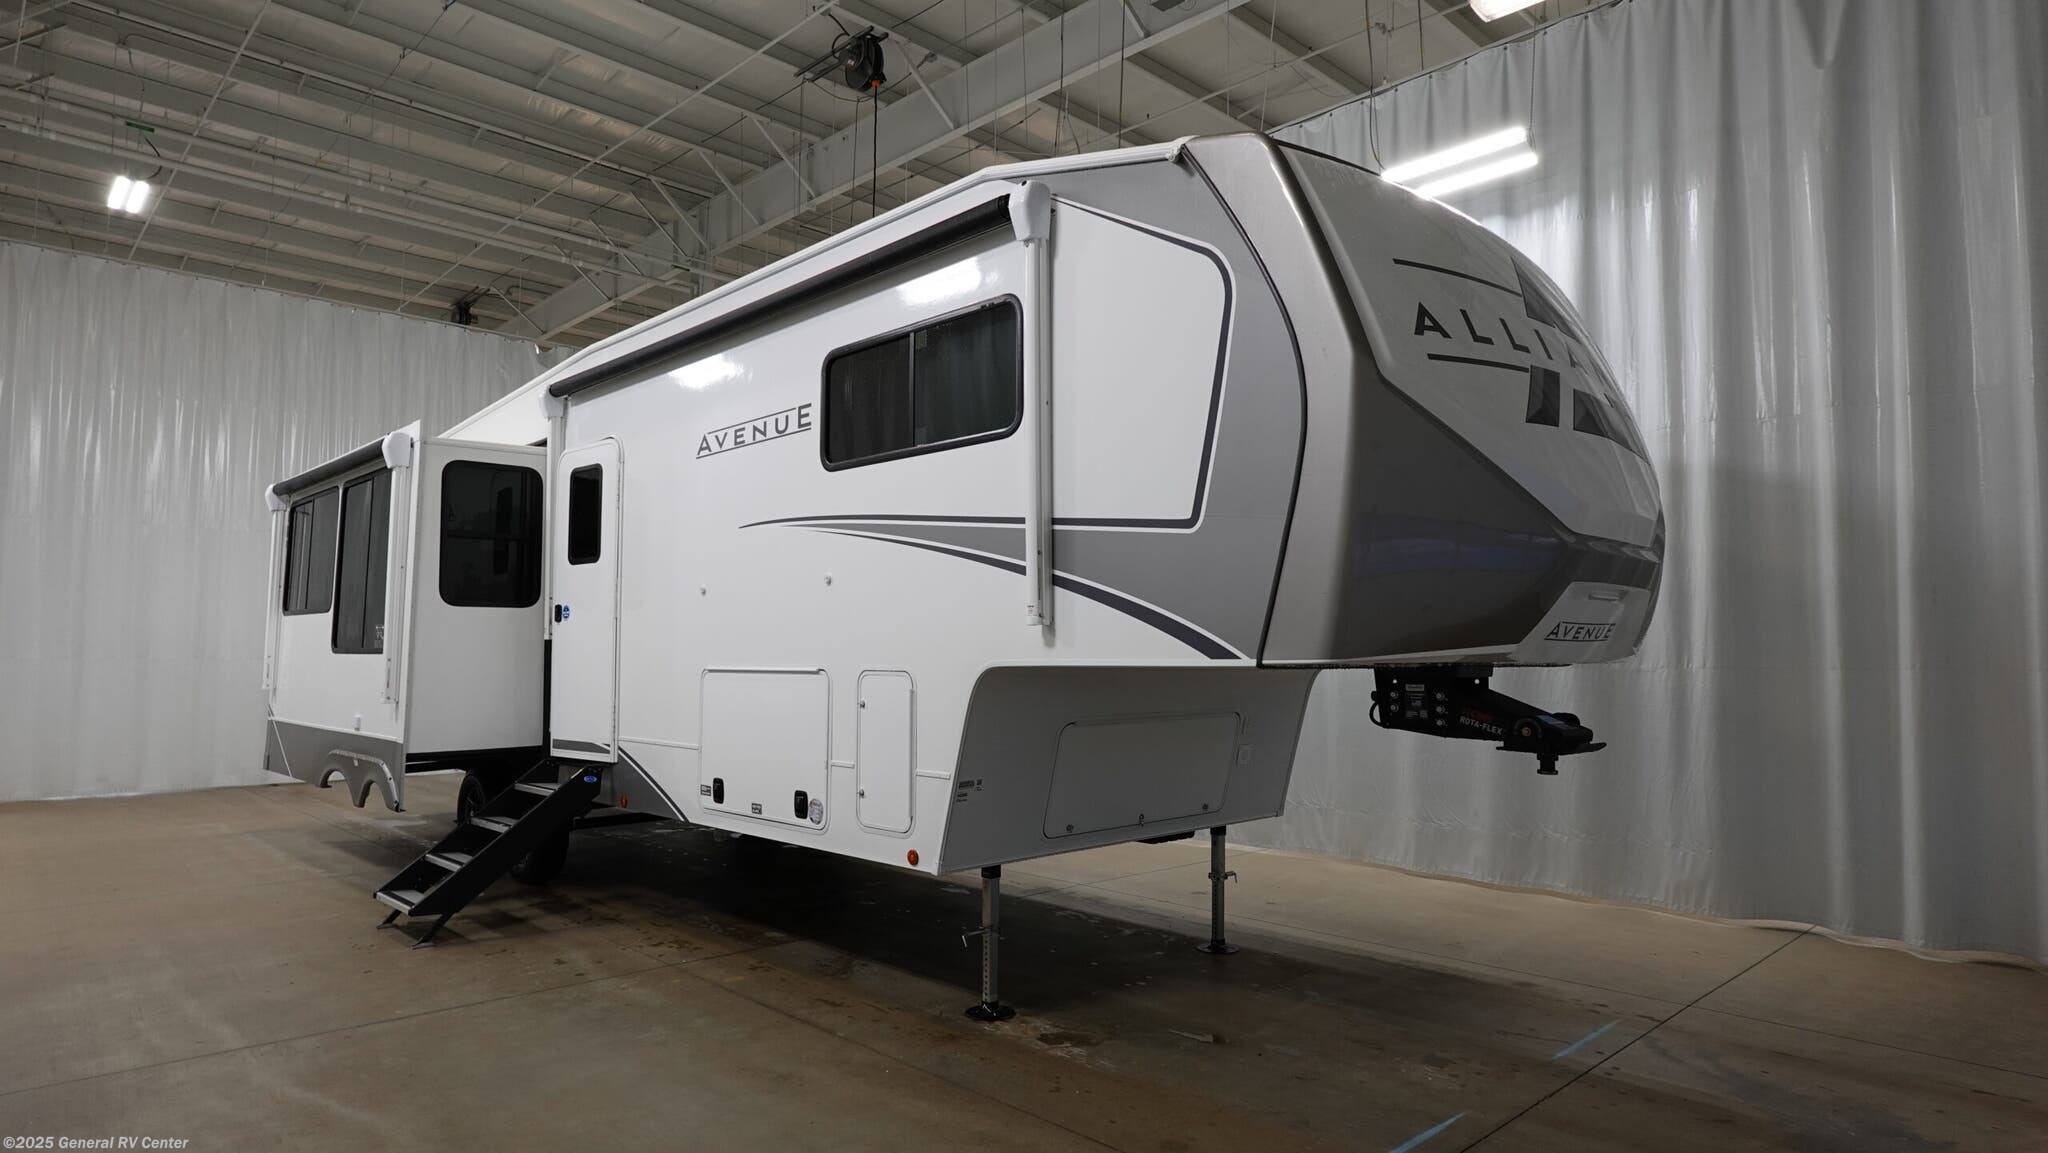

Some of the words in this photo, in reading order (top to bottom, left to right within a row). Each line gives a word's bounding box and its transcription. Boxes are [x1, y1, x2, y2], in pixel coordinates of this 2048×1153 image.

[697, 403, 812, 456] AVENUE
[1546, 621, 1616, 640] AVENUE
[1459, 715, 1503, 736] ROTA-FLEX
